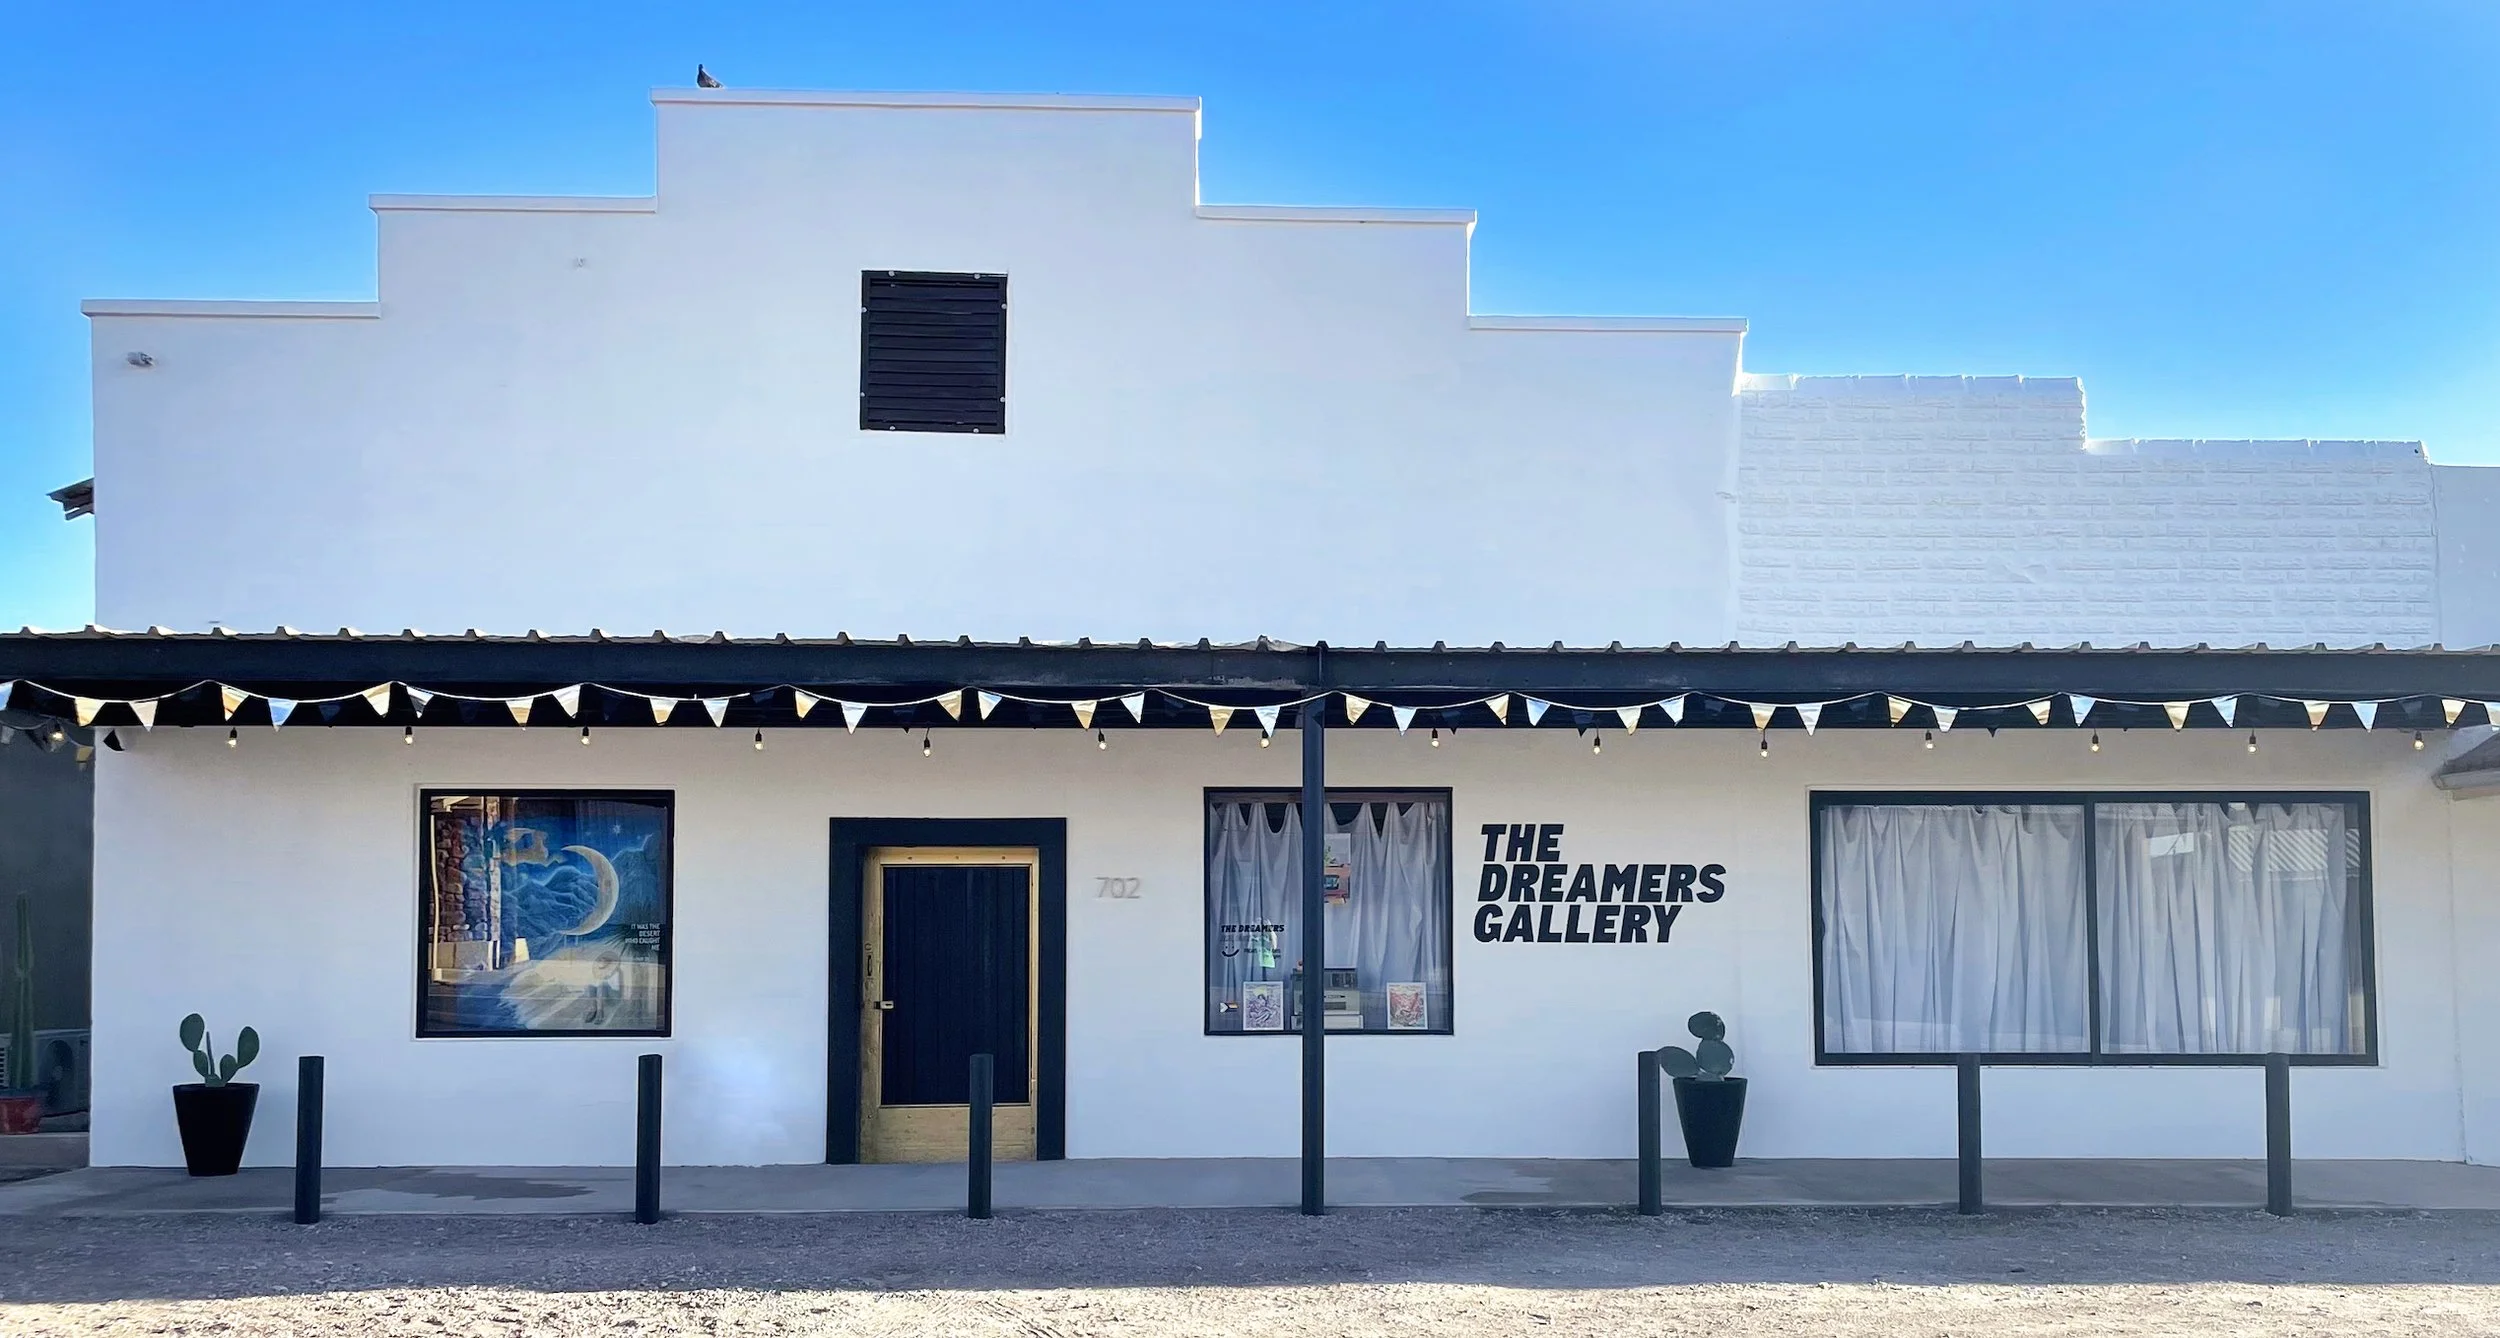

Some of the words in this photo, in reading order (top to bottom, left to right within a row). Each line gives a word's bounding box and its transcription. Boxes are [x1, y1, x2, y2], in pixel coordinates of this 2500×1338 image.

[1481, 824, 1564, 862] THE
[1094, 876, 1140, 899] 702
[1477, 864, 1727, 903] DREAMERS
[1221, 924, 1236, 932] THE
[1238, 924, 1285, 932] DREAMERS
[1473, 904, 1683, 943] GALLERY
